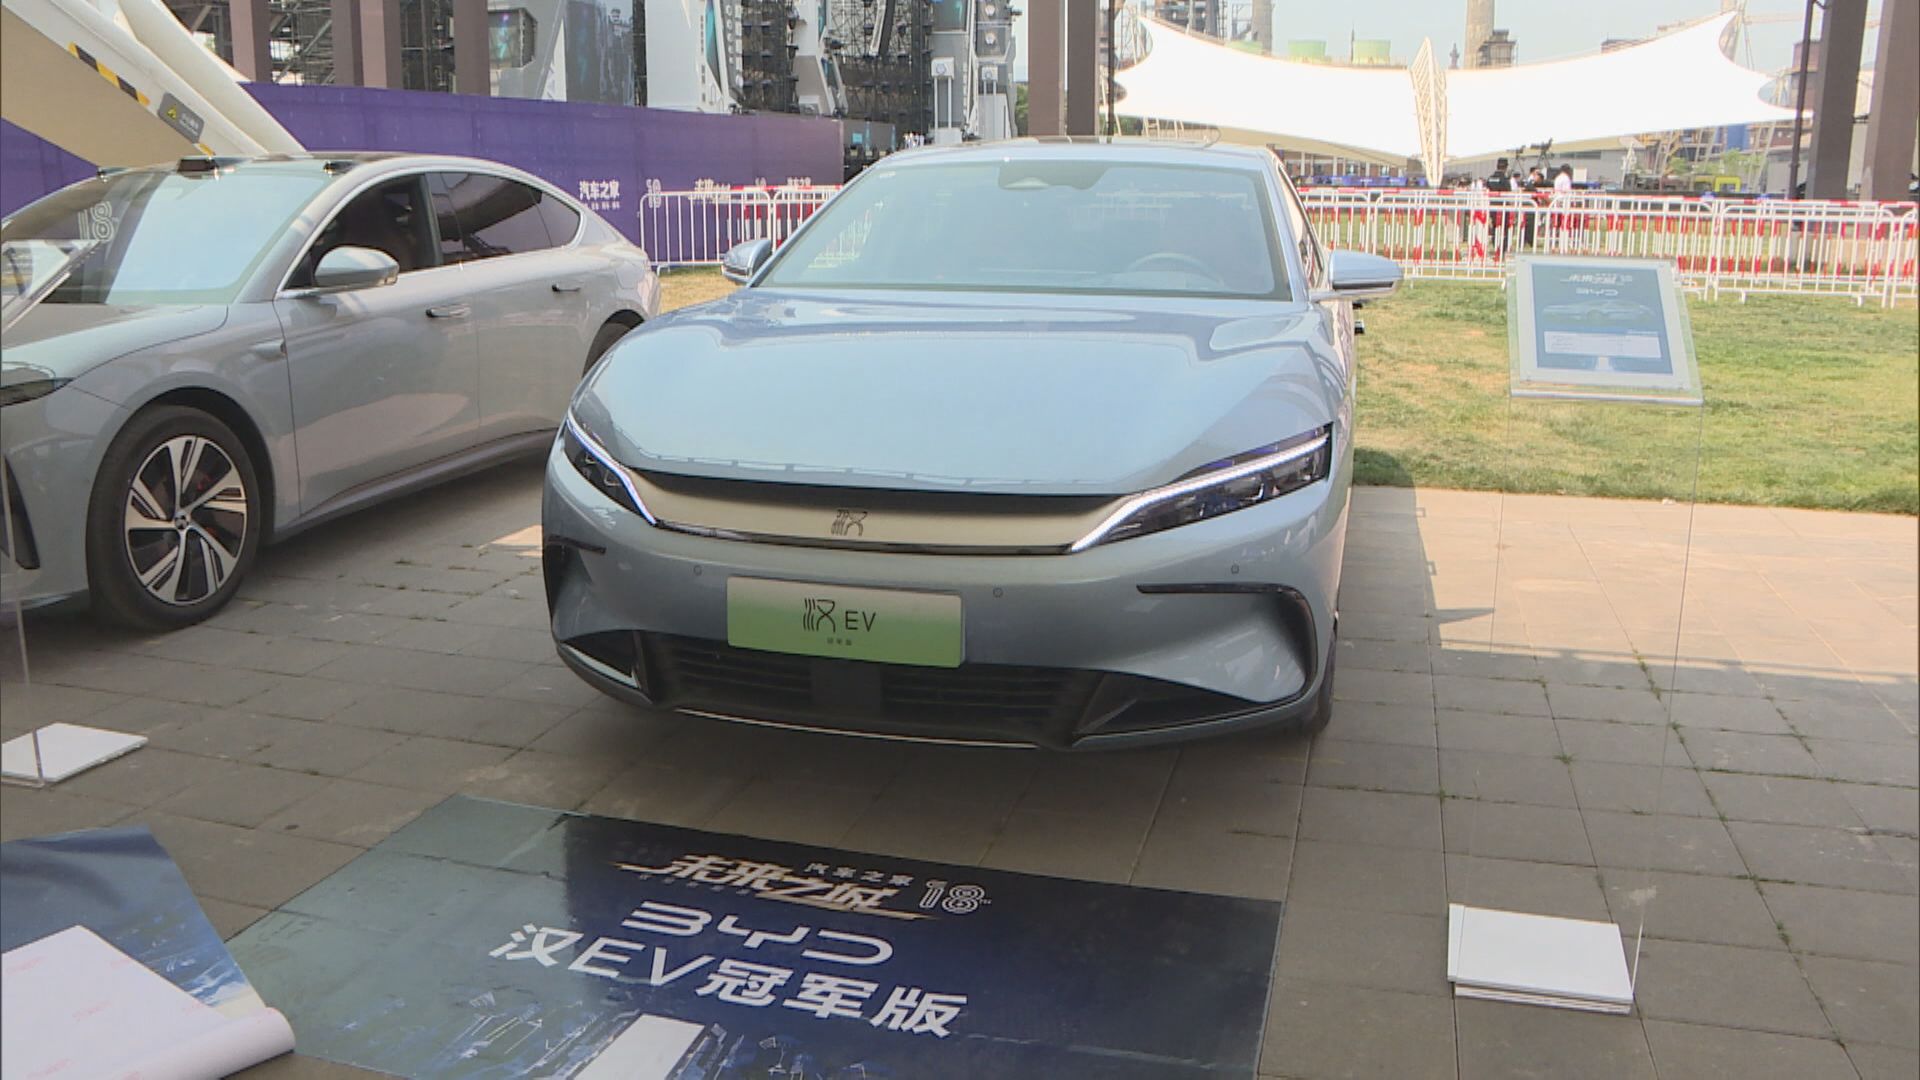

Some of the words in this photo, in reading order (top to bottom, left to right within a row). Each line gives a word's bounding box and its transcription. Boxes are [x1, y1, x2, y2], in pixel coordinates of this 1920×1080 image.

[579, 179, 620, 200] 汽车之家
[804, 863, 915, 887] 汽车之家
[919, 880, 986, 915] 18
[621, 901, 894, 965] BYD
[488, 923, 968, 1038] 汉EV冠军版
